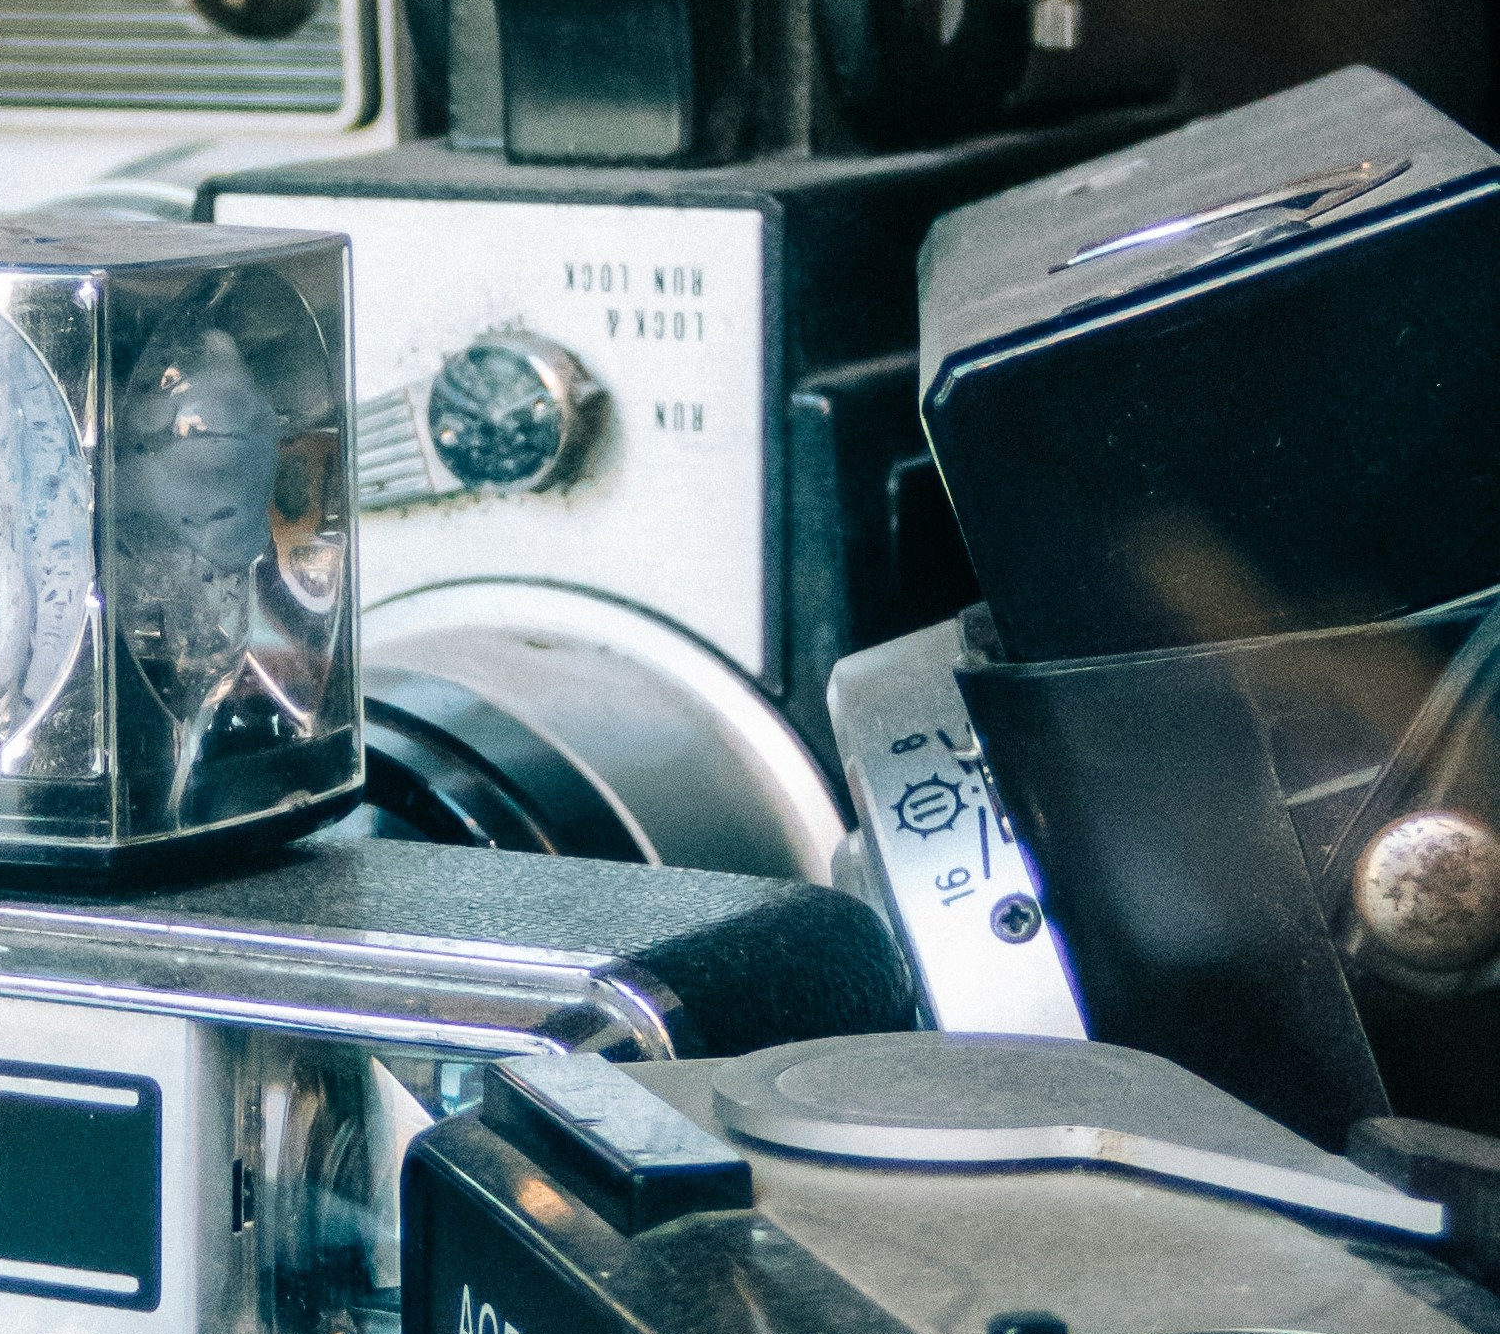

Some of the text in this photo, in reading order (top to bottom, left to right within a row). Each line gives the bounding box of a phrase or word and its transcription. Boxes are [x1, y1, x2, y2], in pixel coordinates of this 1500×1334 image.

[563, 262, 629, 293] LOCK
[634, 309, 703, 341] LOCK
[654, 401, 703, 432] RUN
